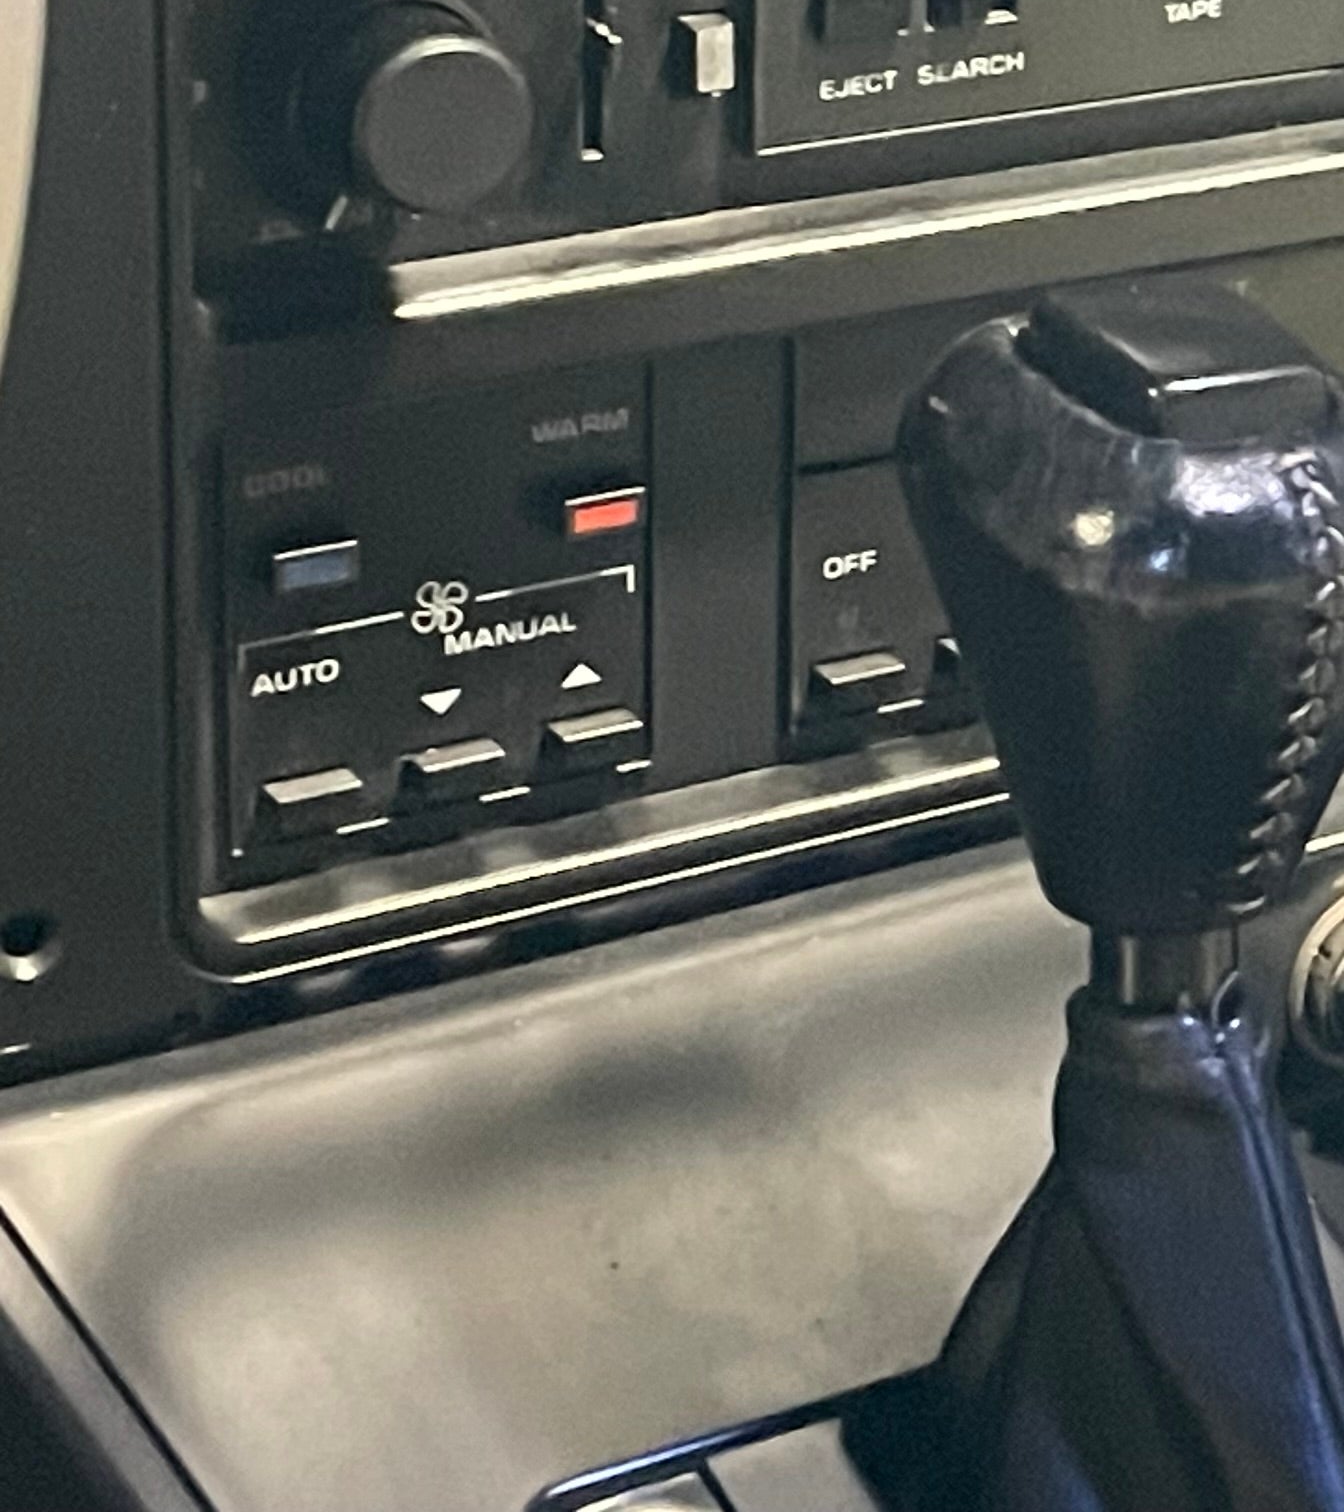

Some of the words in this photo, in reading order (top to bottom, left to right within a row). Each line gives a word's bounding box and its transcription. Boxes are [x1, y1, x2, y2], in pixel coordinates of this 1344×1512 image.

[819, 70, 898, 101] EJECT
[917, 52, 1025, 85] SEARCH
[531, 408, 630, 443] WARM
[823, 549, 877, 580] OFF
[444, 612, 578, 655] MANUAL
[251, 658, 340, 697] AUTO
